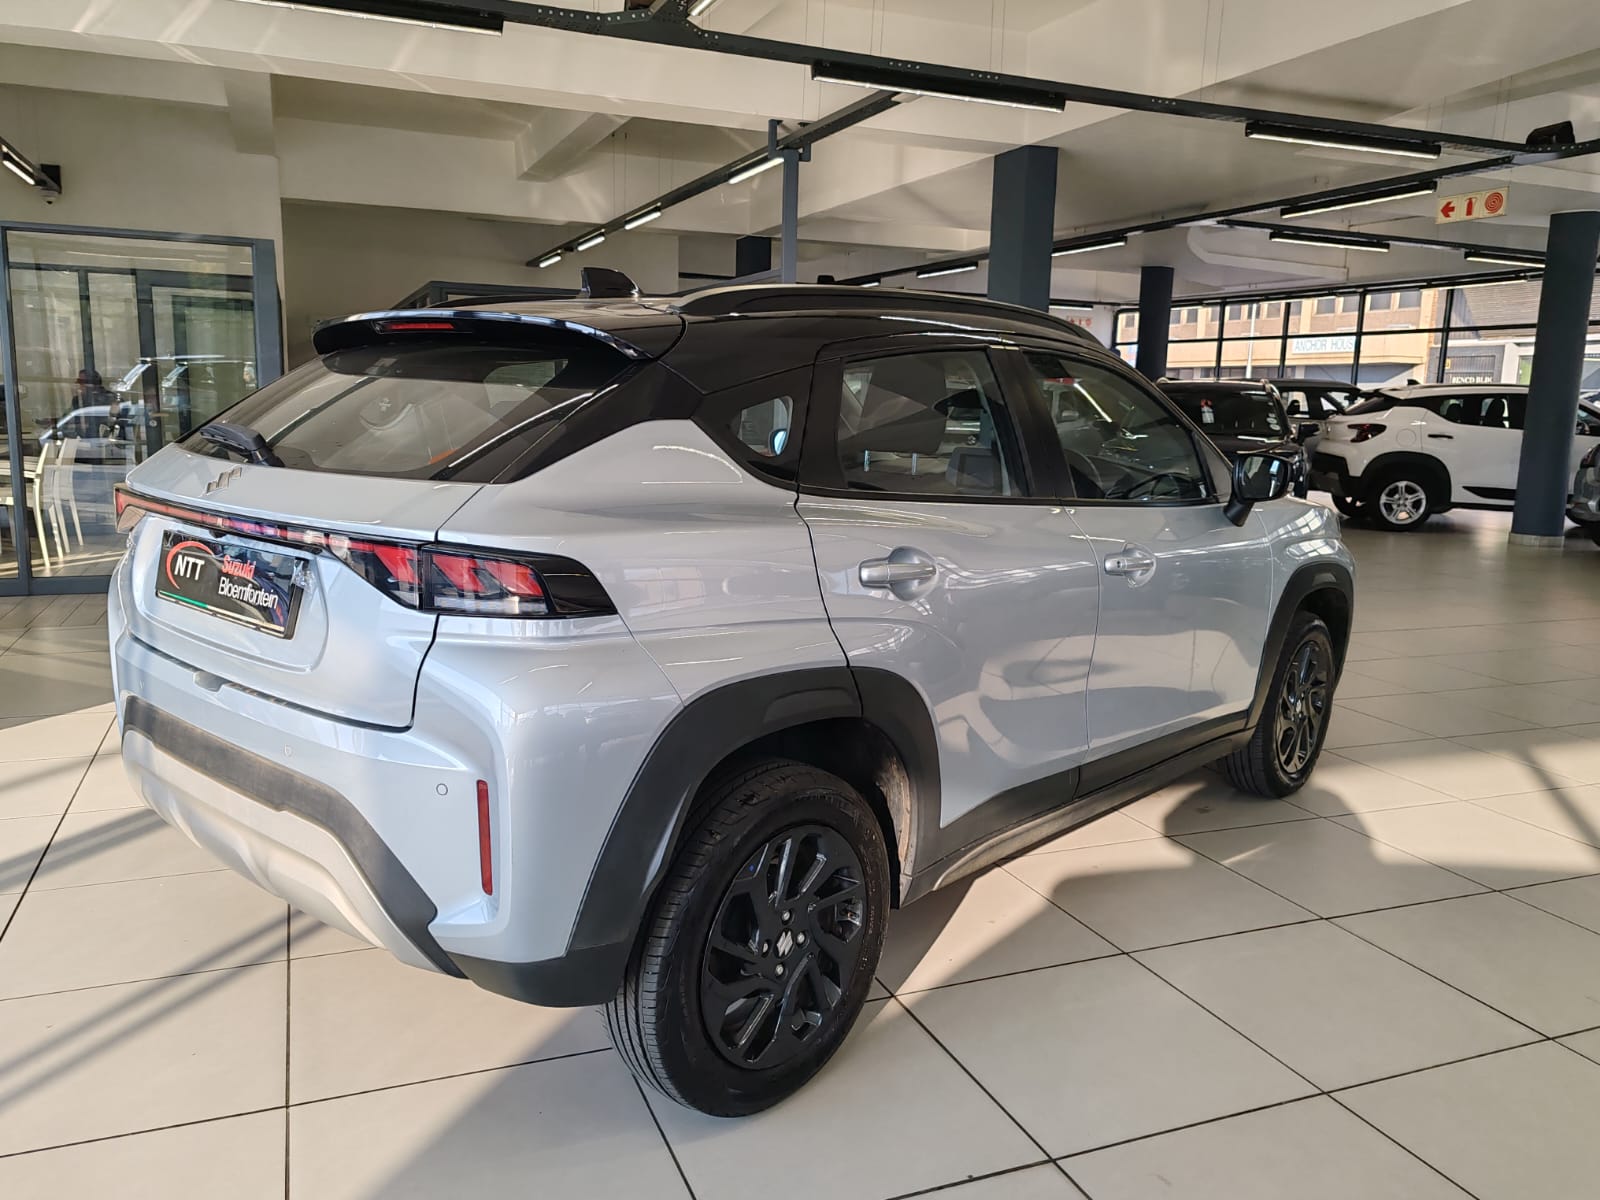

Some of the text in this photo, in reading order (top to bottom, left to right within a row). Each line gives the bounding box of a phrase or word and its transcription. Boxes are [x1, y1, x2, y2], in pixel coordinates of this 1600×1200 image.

[1294, 338, 1354, 352] ANCHOR HOUS
[174, 554, 205, 581] NTT
[221, 555, 257, 580] Suzuki
[218, 576, 279, 610] Bloemfontein
